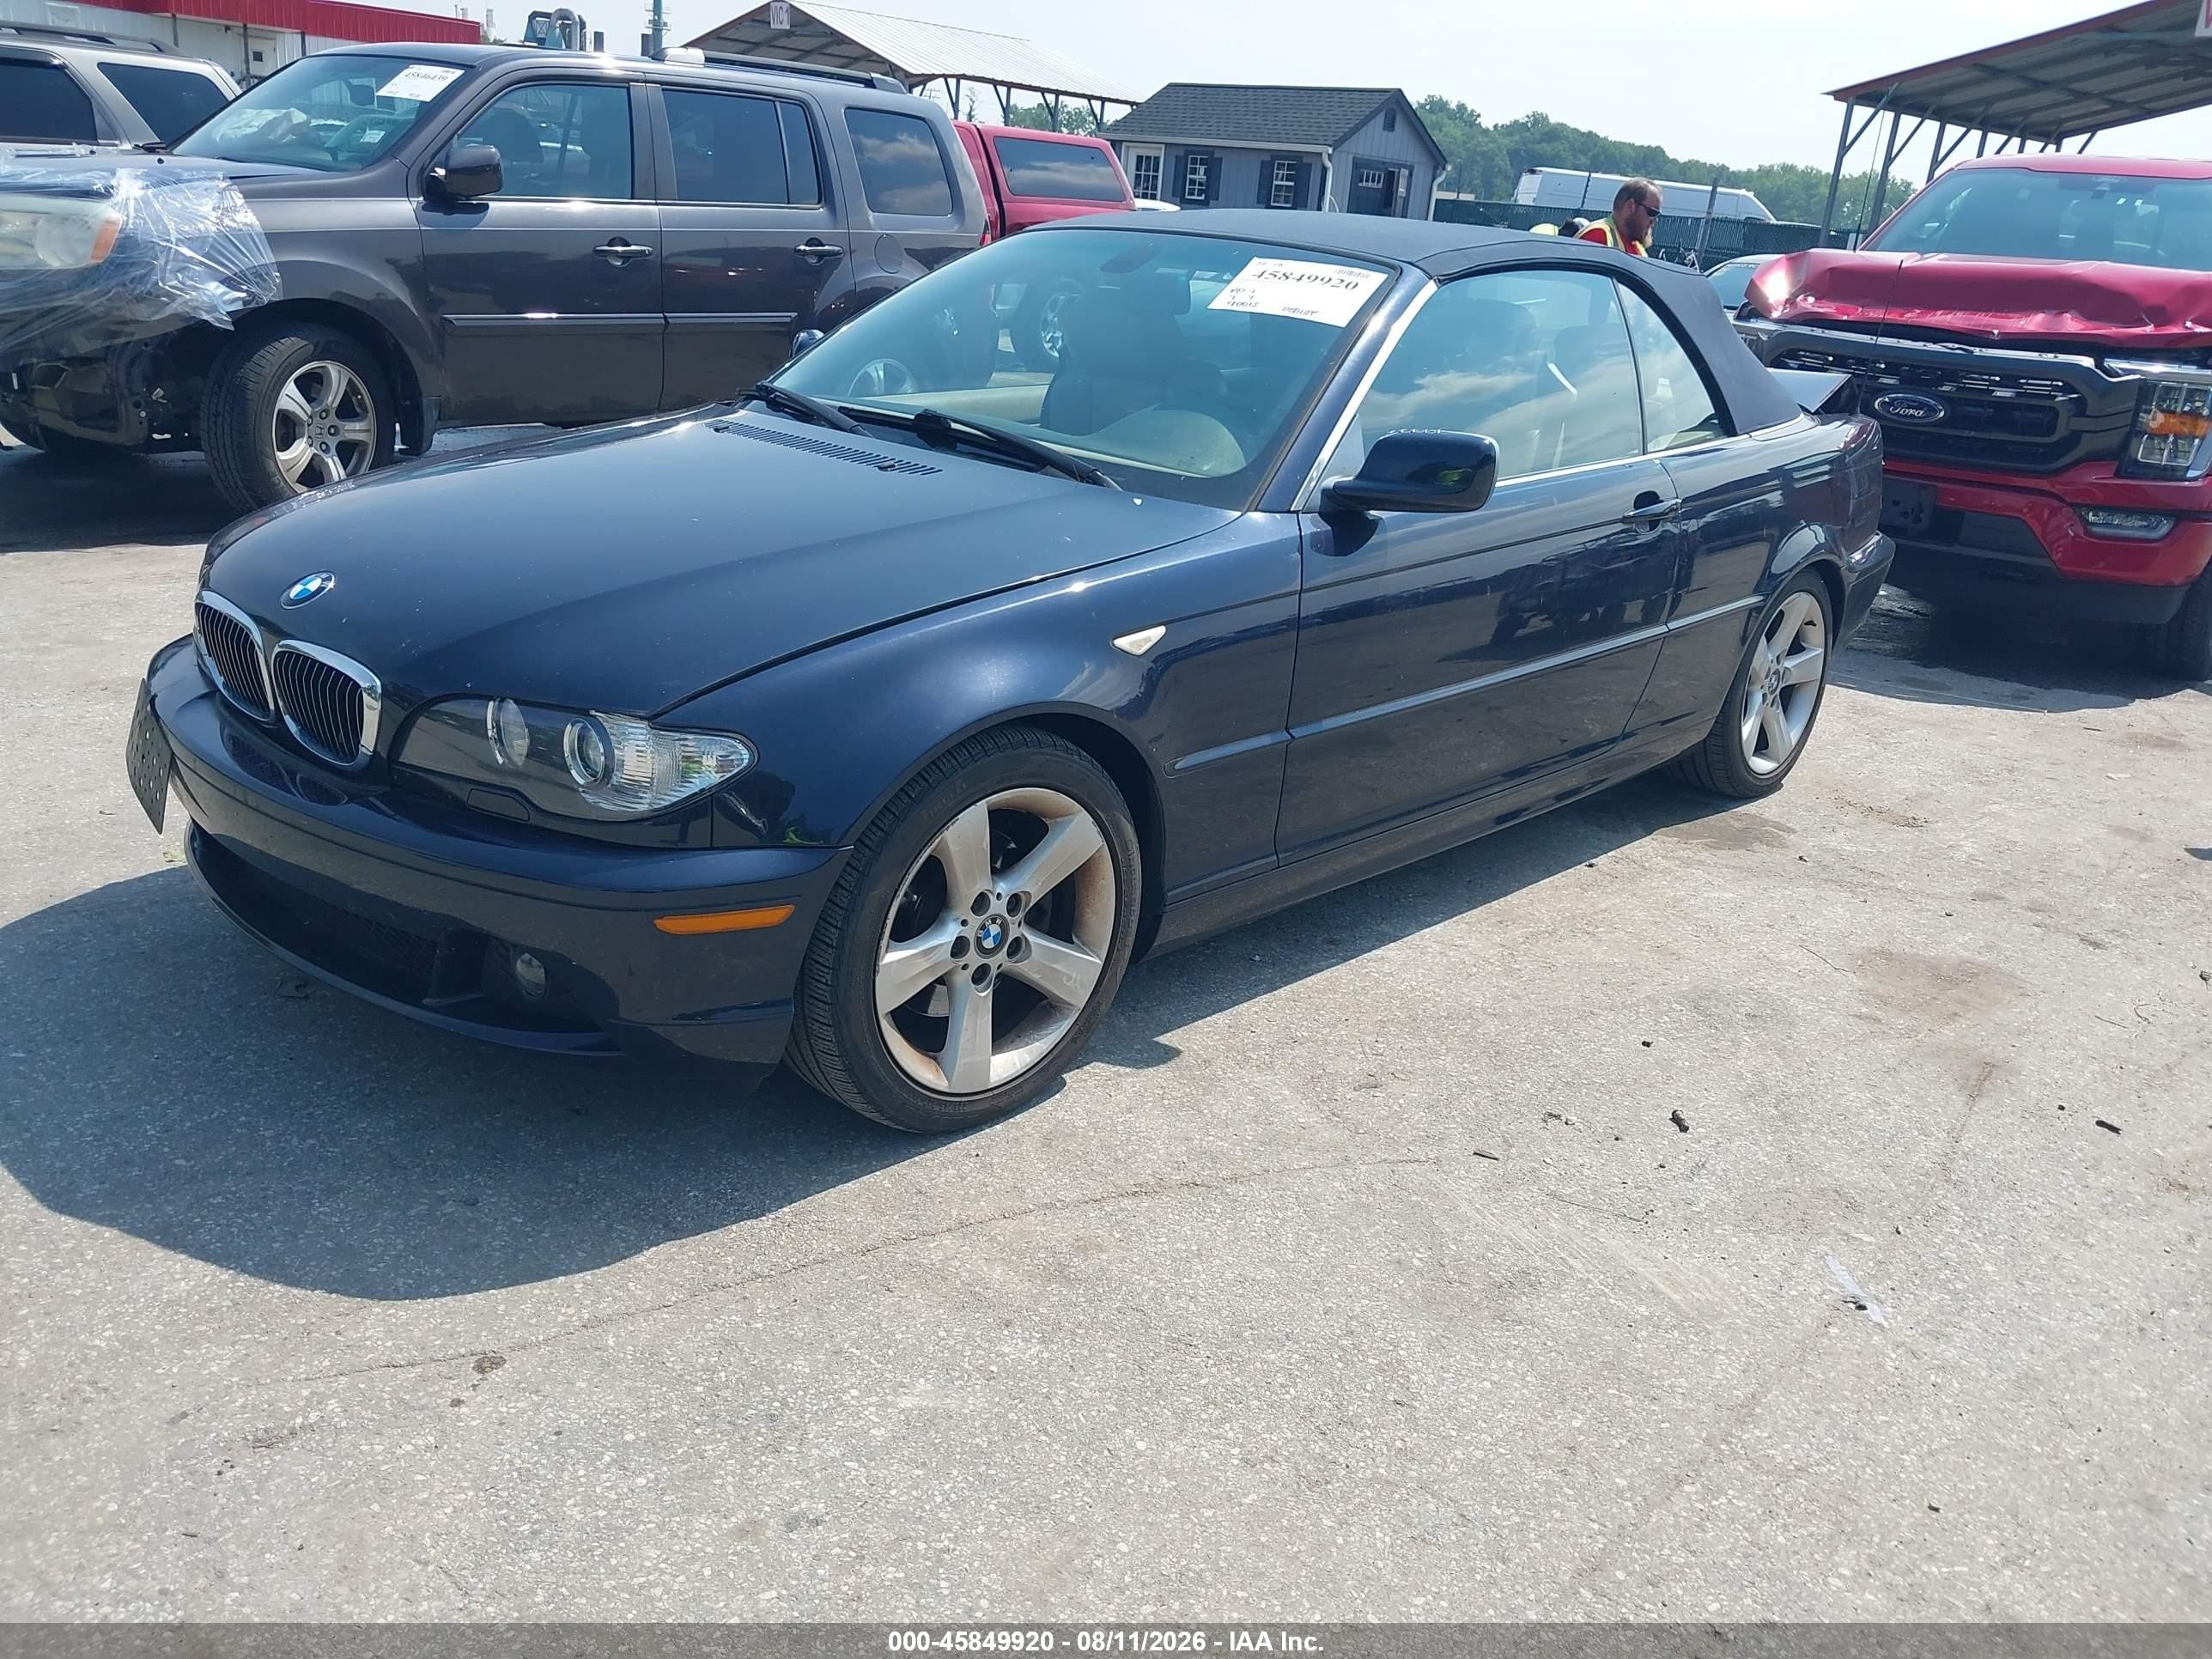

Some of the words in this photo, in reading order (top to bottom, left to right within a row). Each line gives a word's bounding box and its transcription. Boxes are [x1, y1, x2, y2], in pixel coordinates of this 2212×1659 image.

[771, 6, 784, 25] VIC
[1252, 269, 1359, 291] 45849920
[1889, 399, 1928, 417] Ford
